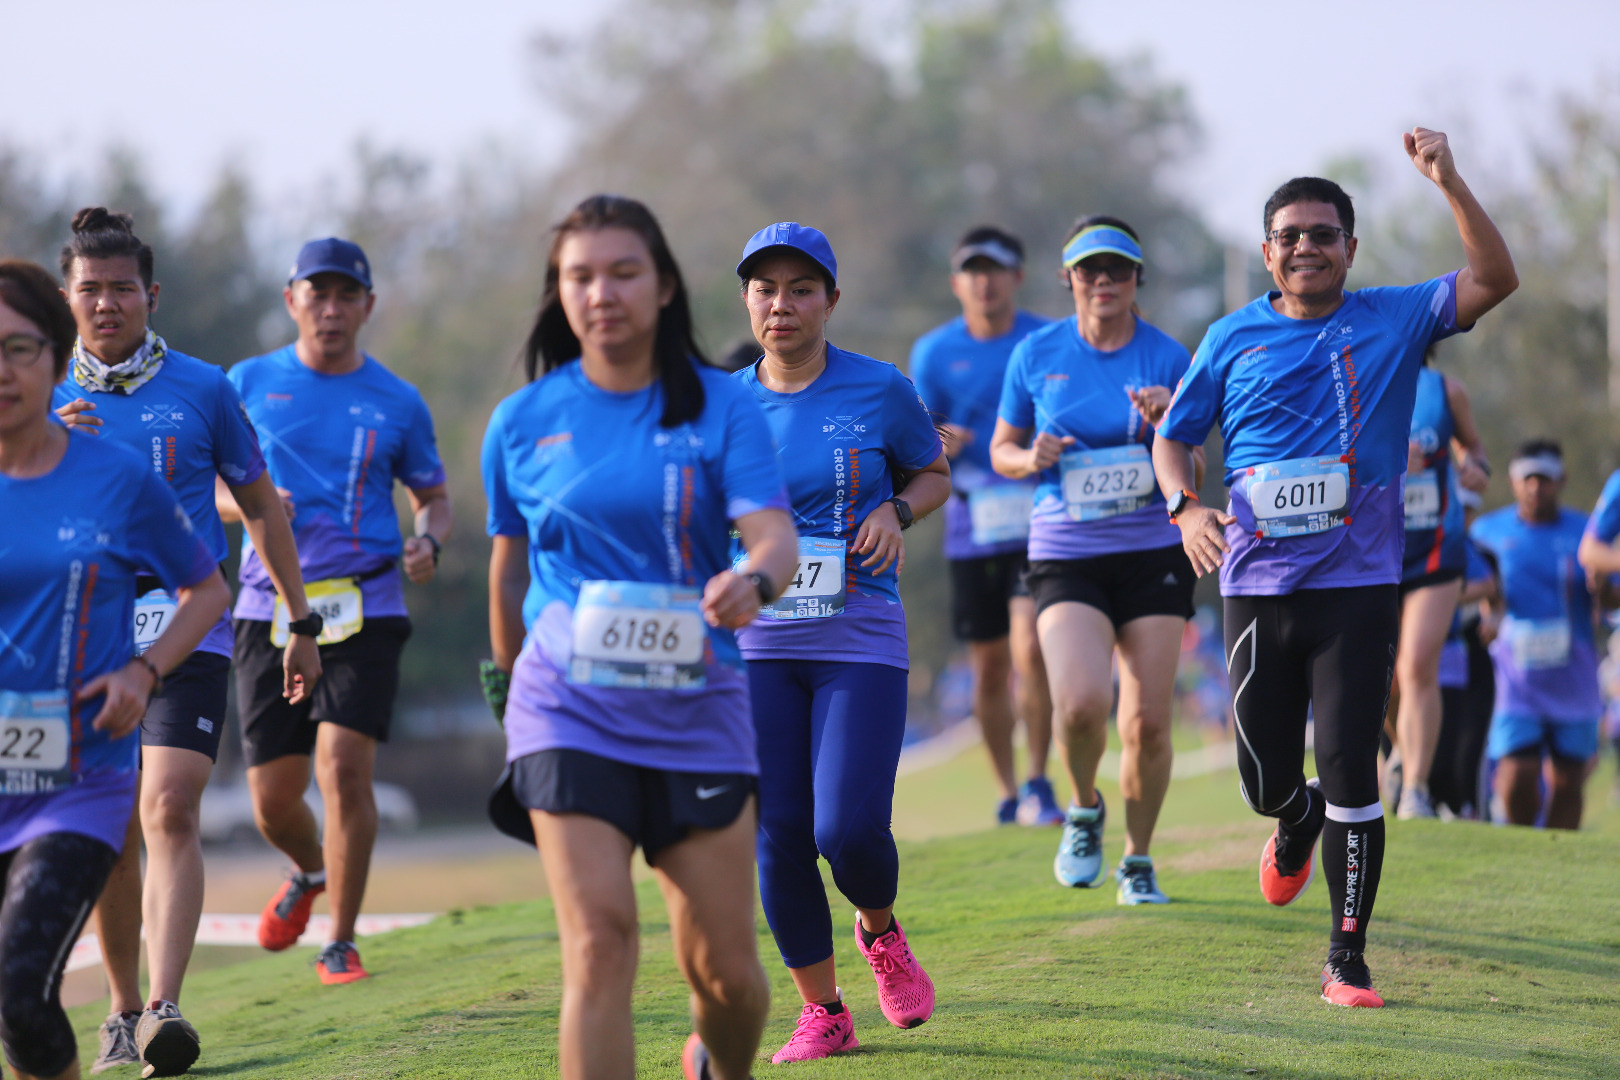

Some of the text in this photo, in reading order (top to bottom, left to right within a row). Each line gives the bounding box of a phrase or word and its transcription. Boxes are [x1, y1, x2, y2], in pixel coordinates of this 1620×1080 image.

[1342, 345, 1358, 388] SINGHA
[141, 412, 184, 422] SP XC
[1335, 382, 1349, 431] COUNTRY
[822, 424, 867, 433] SP XC
[152, 436, 163, 473] CROSS
[833, 447, 846, 487] CROSS
[848, 447, 860, 497] SINGHA
[1083, 468, 1140, 495] 6232
[1274, 480, 1326, 509] 6011
[135, 611, 165, 636] 97
[820, 603, 833, 616] 16
[601, 616, 680, 653] 6186
[0, 727, 45, 759] 22
